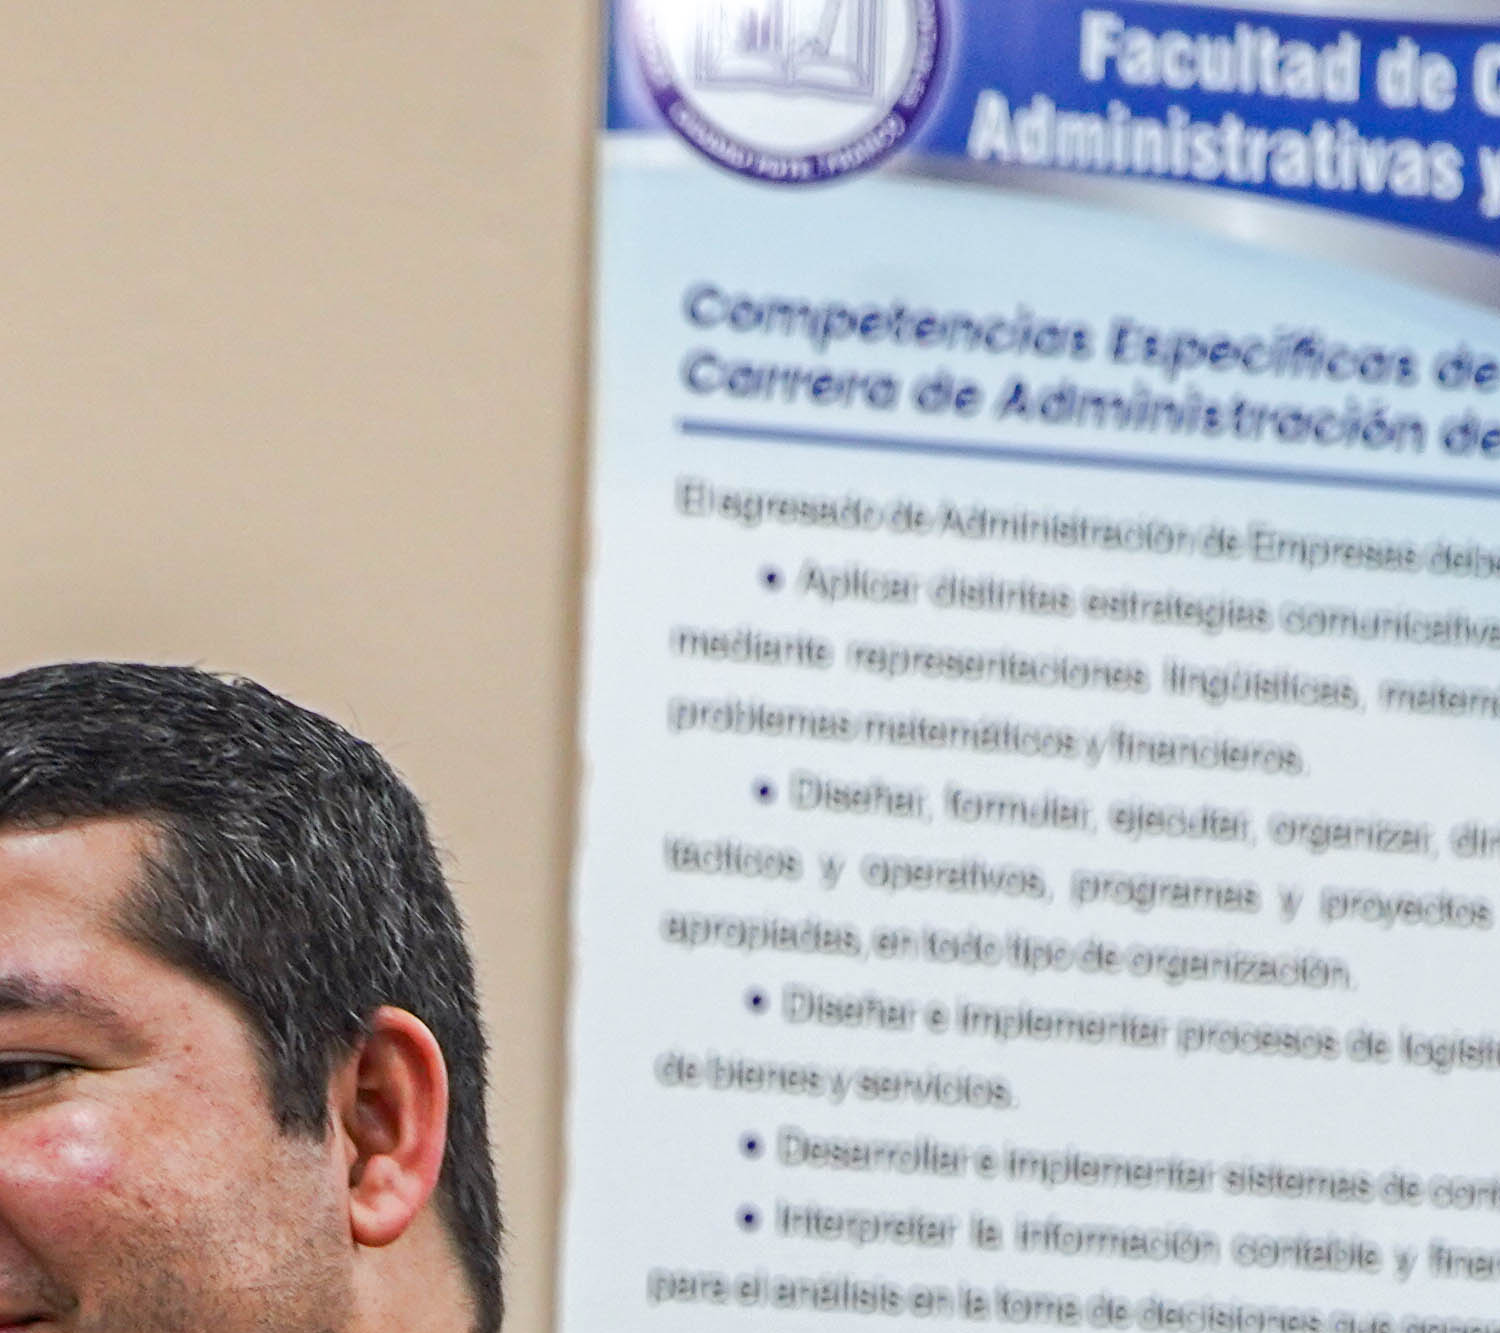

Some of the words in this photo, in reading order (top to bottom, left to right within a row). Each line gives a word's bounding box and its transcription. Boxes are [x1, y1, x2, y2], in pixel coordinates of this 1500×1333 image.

[1079, 8, 1361, 103] Facultad
[1376, 35, 1457, 111] de
[967, 88, 1464, 200] Administrativas
[680, 280, 1096, 360] Competencias
[1110, 313, 1419, 387] Específicas
[678, 347, 901, 411] Carrera
[910, 363, 985, 418] de
[995, 372, 1428, 453] Administración
[796, 558, 921, 610] Aplicar
[926, 571, 1077, 620] distintas
[1079, 584, 1275, 640] estrategias
[954, 1001, 1169, 1051] implementar
[1174, 1017, 1342, 1063] procesos
